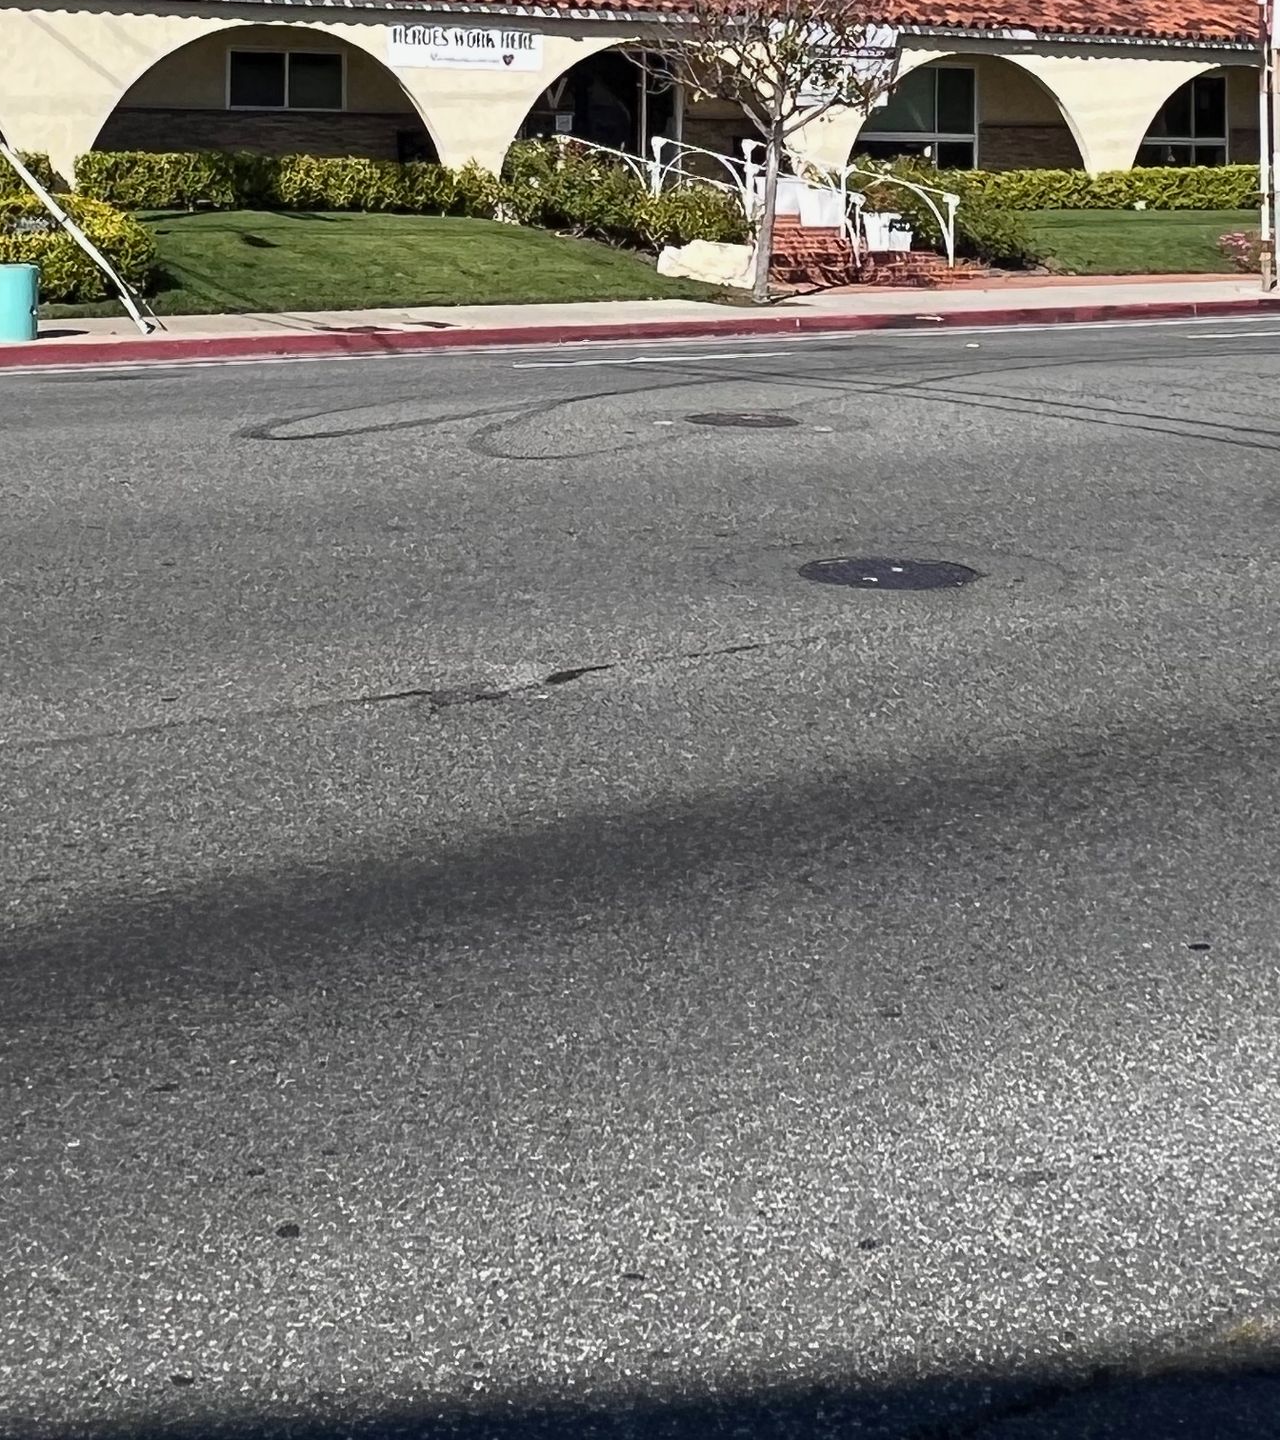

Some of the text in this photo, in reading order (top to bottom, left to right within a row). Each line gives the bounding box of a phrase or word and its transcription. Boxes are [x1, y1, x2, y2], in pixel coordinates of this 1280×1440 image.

[393, 27, 536, 50] HEROES WORK HERE
